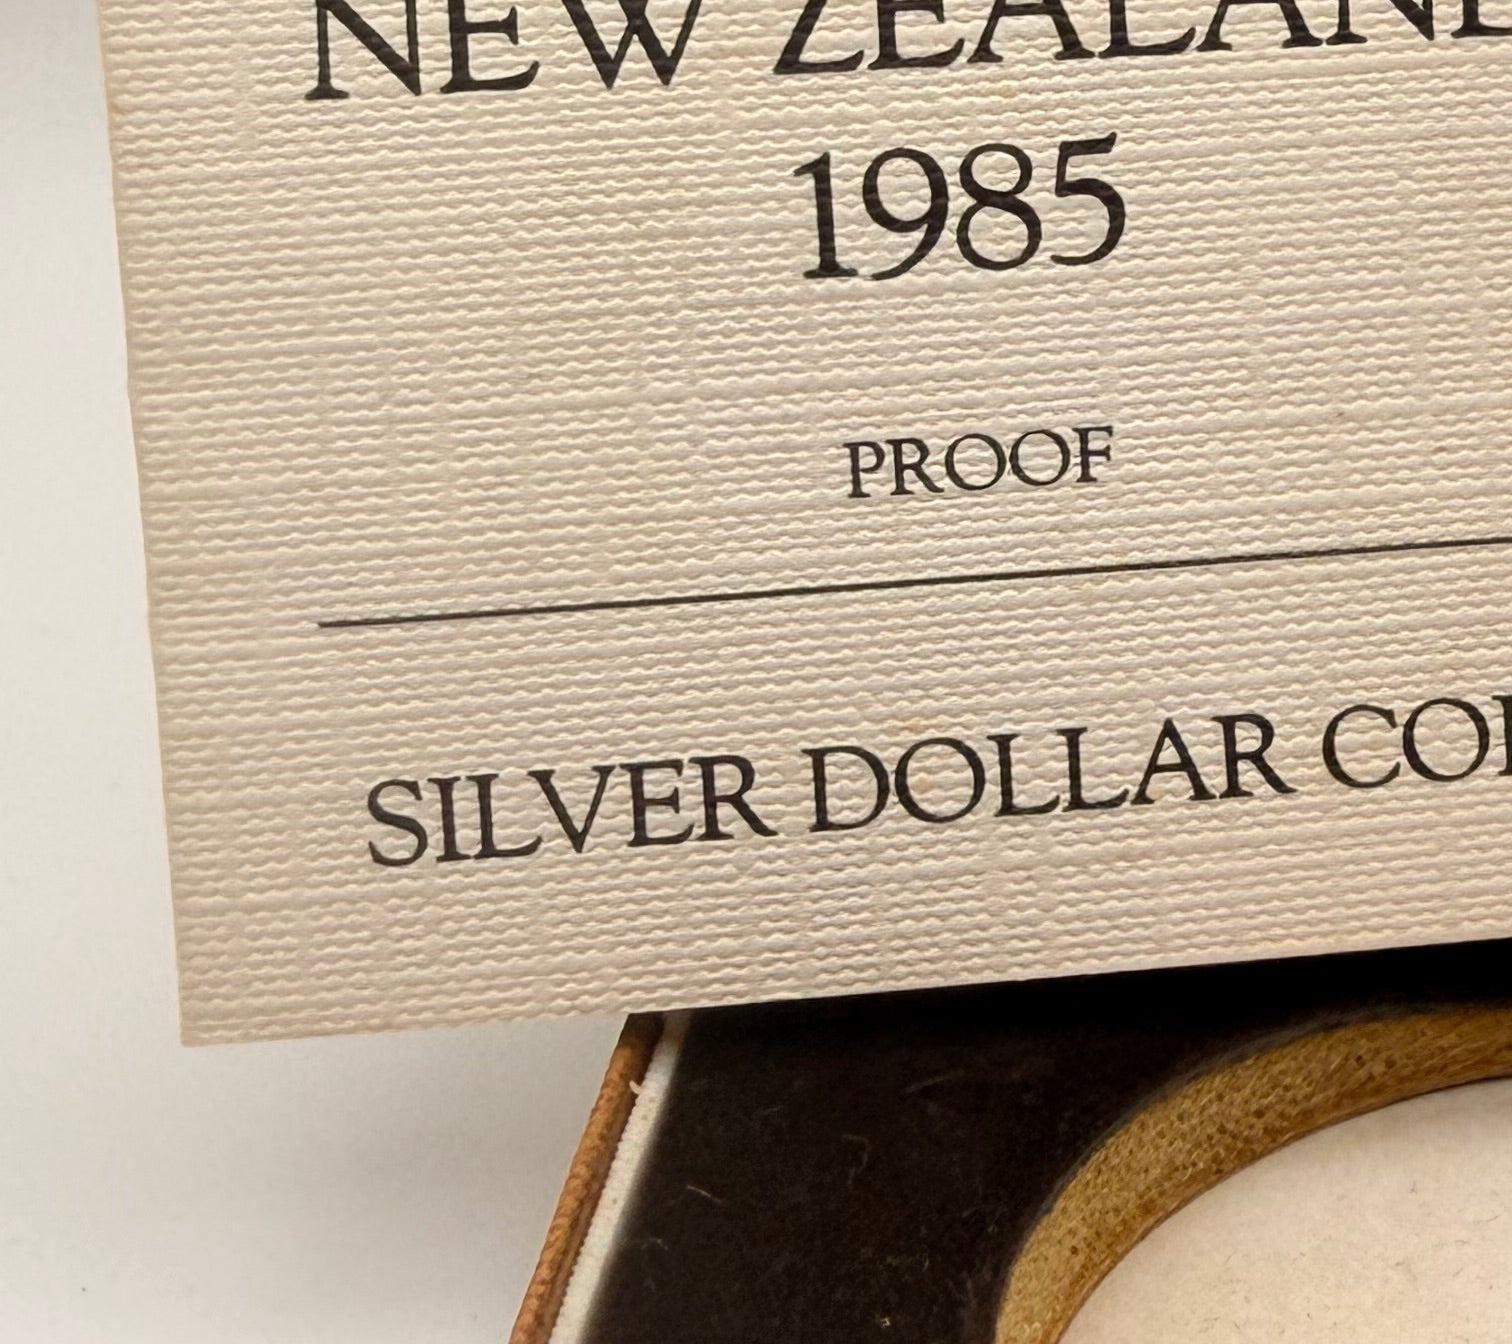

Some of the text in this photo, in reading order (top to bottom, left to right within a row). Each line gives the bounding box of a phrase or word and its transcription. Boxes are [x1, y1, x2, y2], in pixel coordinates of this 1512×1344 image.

[794, 132, 1127, 281] 1985
[842, 425, 1115, 500] PROOF
[367, 755, 779, 867] SILVER
[801, 713, 1298, 833] DOLLAR
